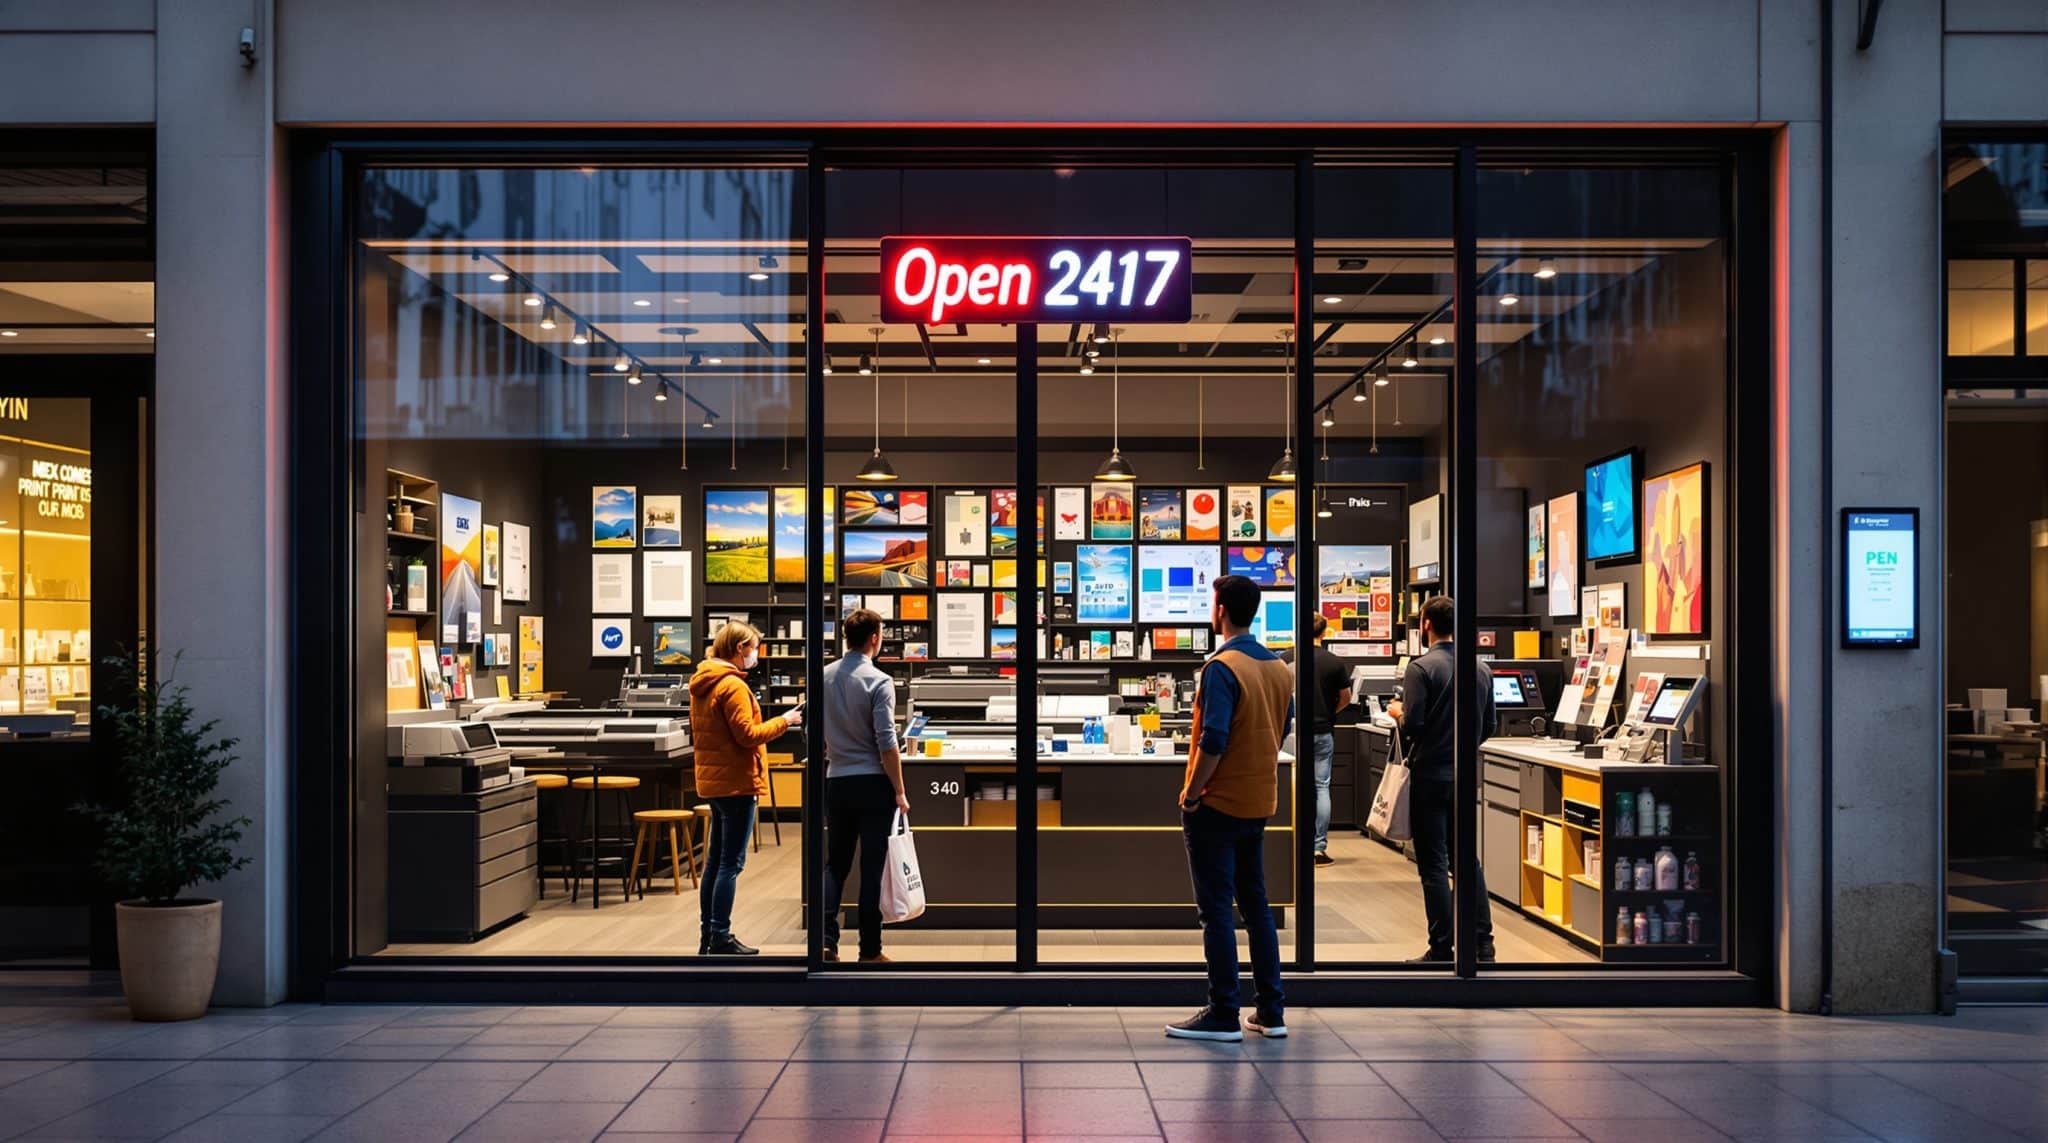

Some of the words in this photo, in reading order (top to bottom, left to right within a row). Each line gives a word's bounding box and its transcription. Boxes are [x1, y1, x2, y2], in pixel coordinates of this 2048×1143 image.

[894, 247, 1032, 322] Open
[1044, 250, 1180, 306] 2417
[1866, 551, 1898, 565] PEN
[930, 781, 960, 795] 340
